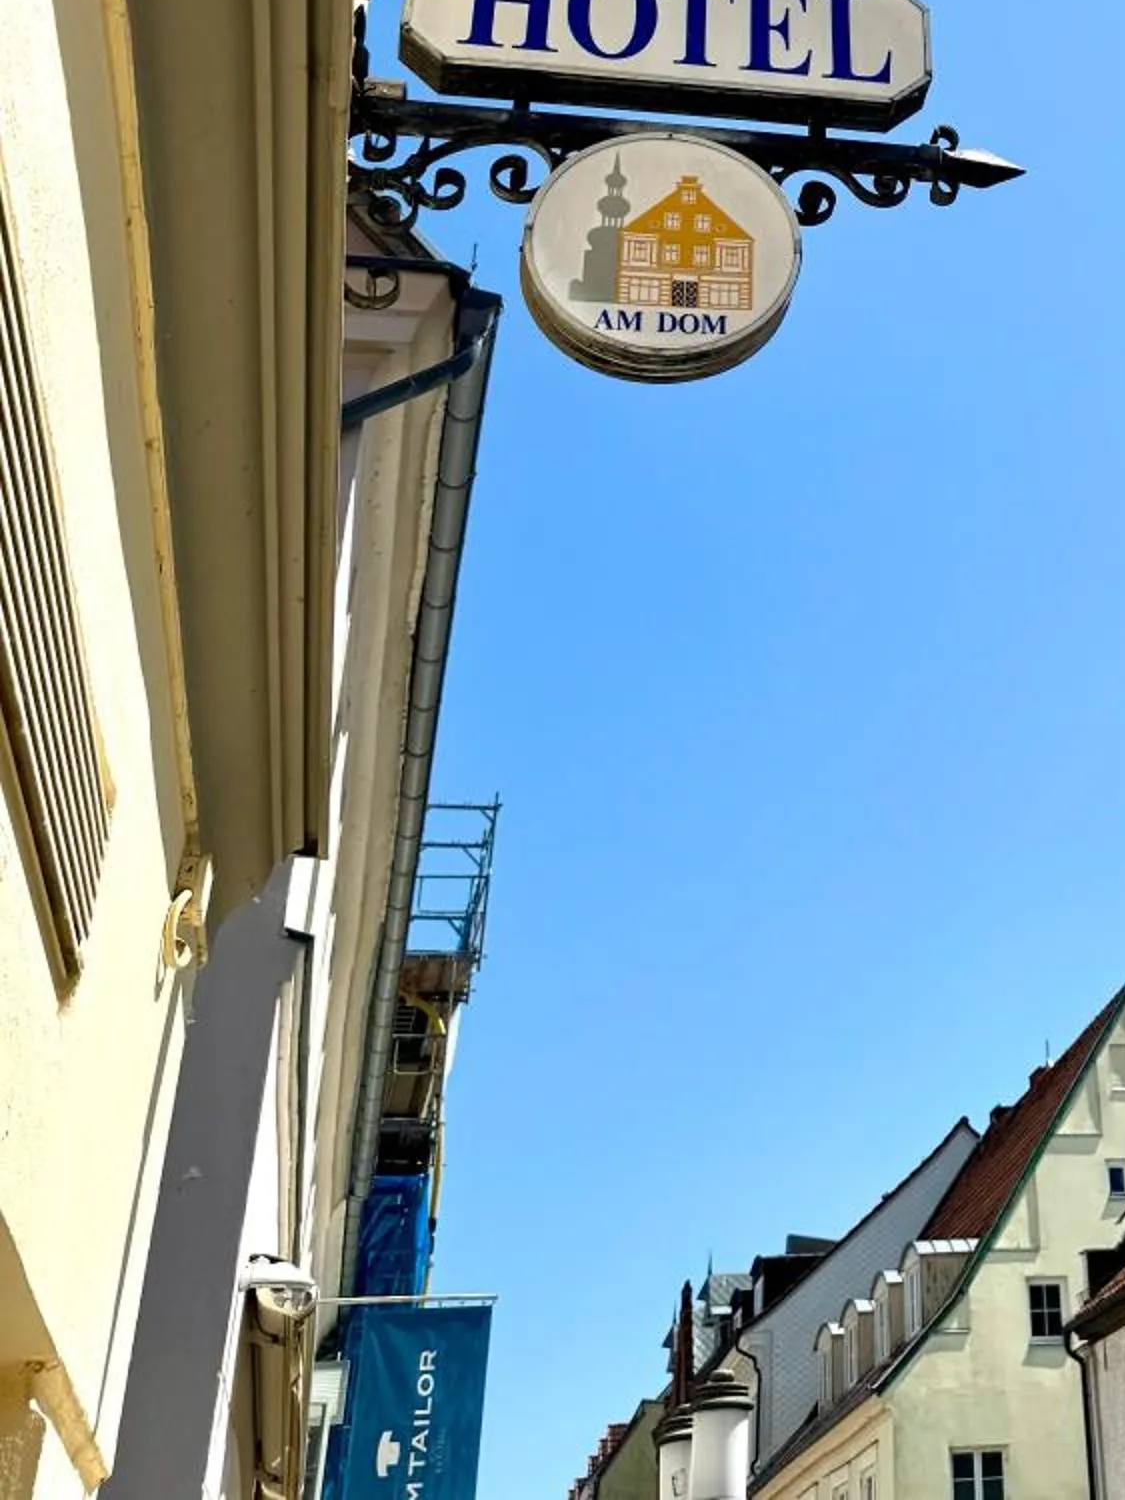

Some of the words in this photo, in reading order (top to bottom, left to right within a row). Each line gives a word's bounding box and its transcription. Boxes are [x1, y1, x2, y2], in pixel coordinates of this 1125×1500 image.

[594, 308, 643, 332] AM
[656, 311, 728, 335] DOM
[408, 1350, 437, 1476] TAILOR
